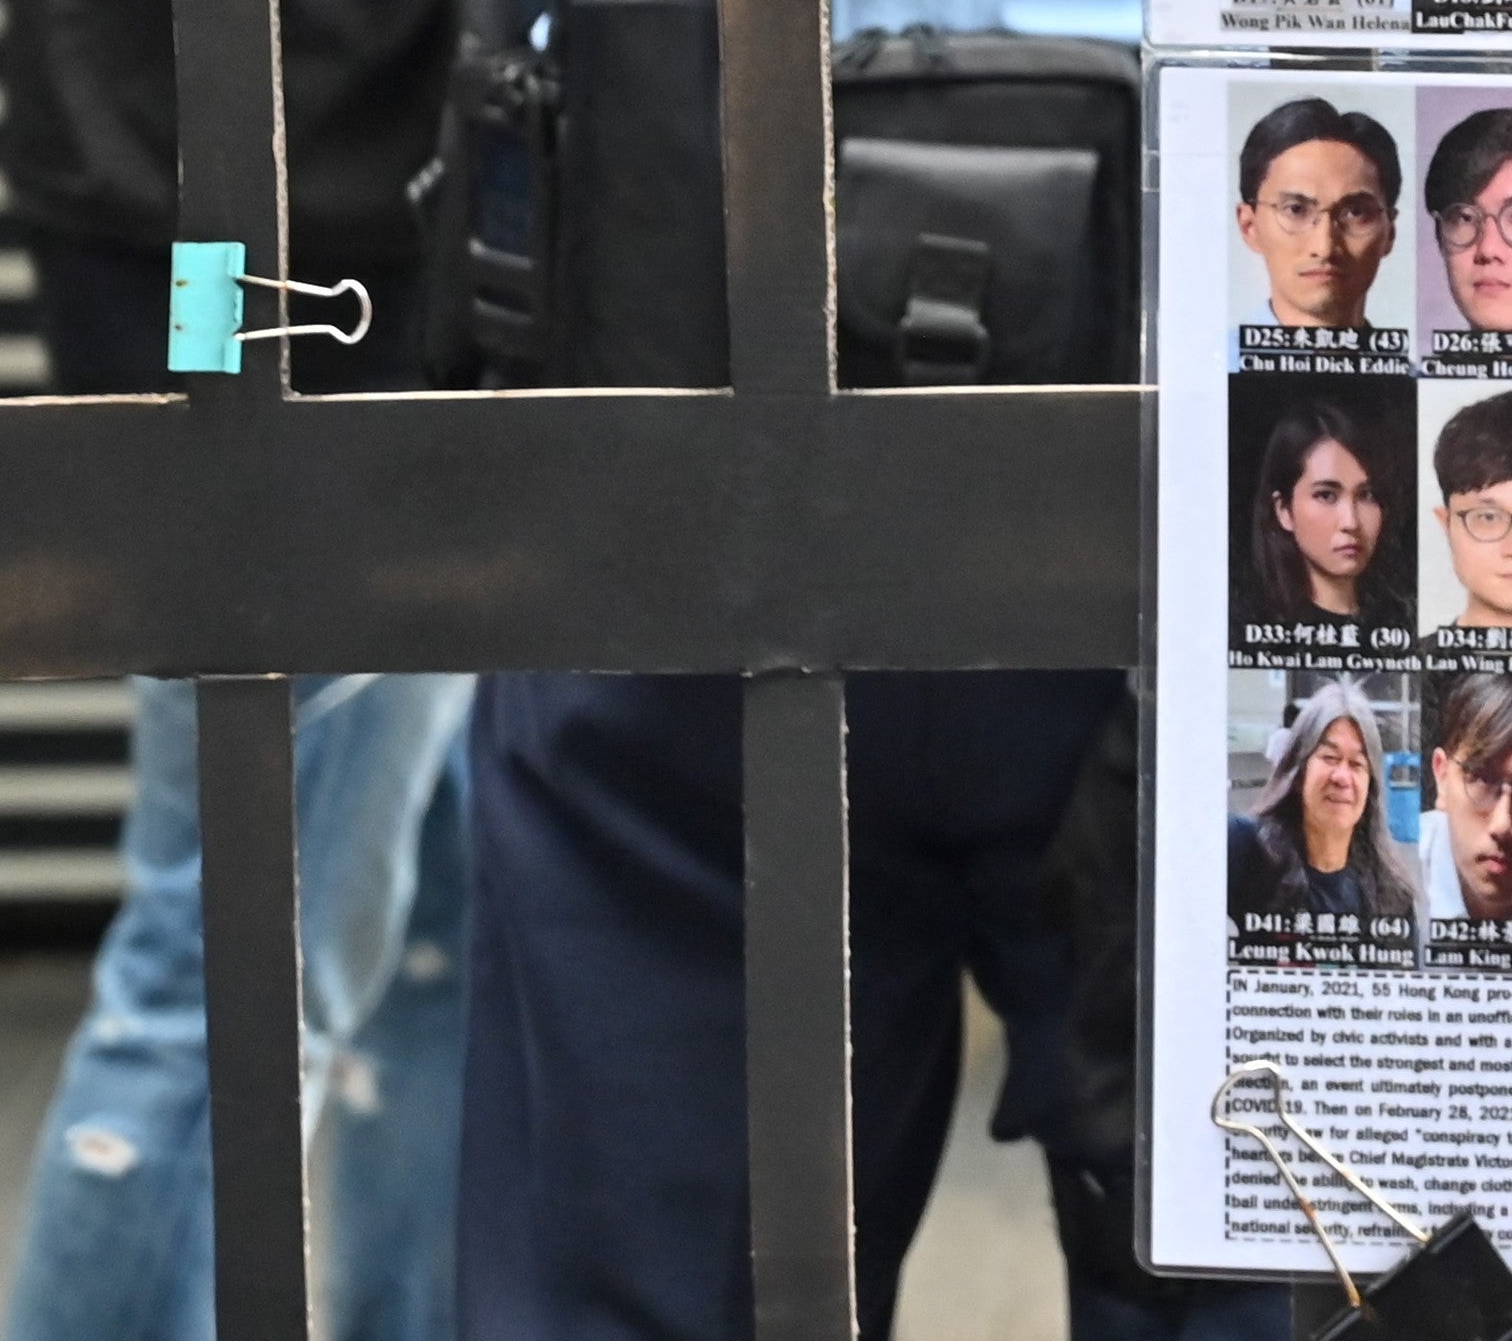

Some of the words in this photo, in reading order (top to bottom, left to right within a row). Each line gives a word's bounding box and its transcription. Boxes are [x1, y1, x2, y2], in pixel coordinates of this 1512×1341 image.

[1221, 13, 1269, 31] Wong
[1276, 14, 1301, 29] Pik
[1307, 15, 1346, 29] Wan
[1352, 15, 1410, 30] Helena
[1240, 356, 1275, 372] Chu
[1280, 356, 1311, 373] Hoi
[1315, 357, 1355, 374] Dick
[1360, 358, 1410, 375] Eddie
[1370, 918, 1410, 939] (64)
[1229, 940, 1290, 963] Leung
[1295, 942, 1354, 961] Kwok
[1359, 943, 1415, 966] Hung
[1425, 948, 1464, 965] Lam
[1469, 949, 1511, 968] King
[1254, 981, 1313, 997] January,
[1322, 981, 1364, 998] 2021,
[1372, 983, 1391, 997] 55
[1399, 983, 1436, 1000] Hong
[1443, 985, 1480, 1001] Kong
